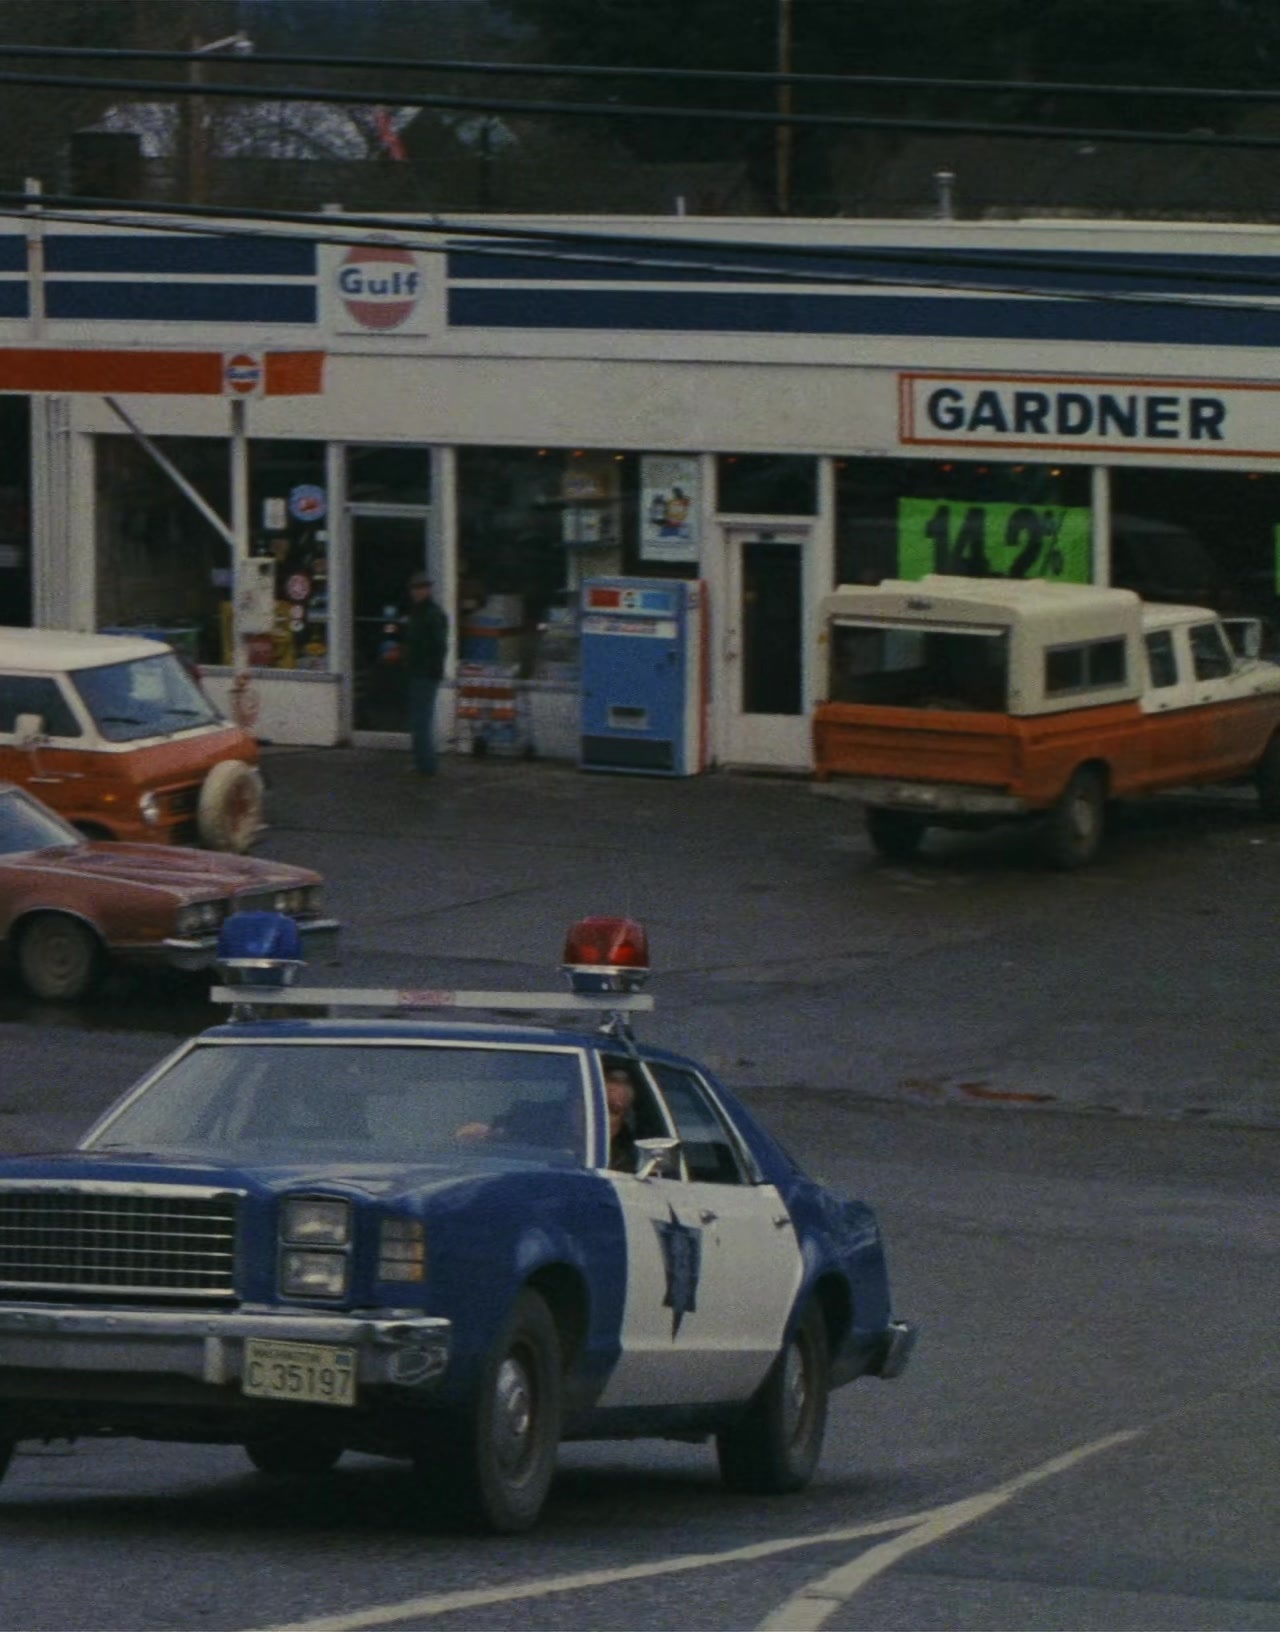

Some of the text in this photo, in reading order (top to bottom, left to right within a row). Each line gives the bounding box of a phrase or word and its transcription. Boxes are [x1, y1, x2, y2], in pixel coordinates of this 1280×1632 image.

[340, 268, 419, 295] Gulf
[928, 388, 1226, 440] GARDNER
[249, 1360, 352, 1396] C 35197
